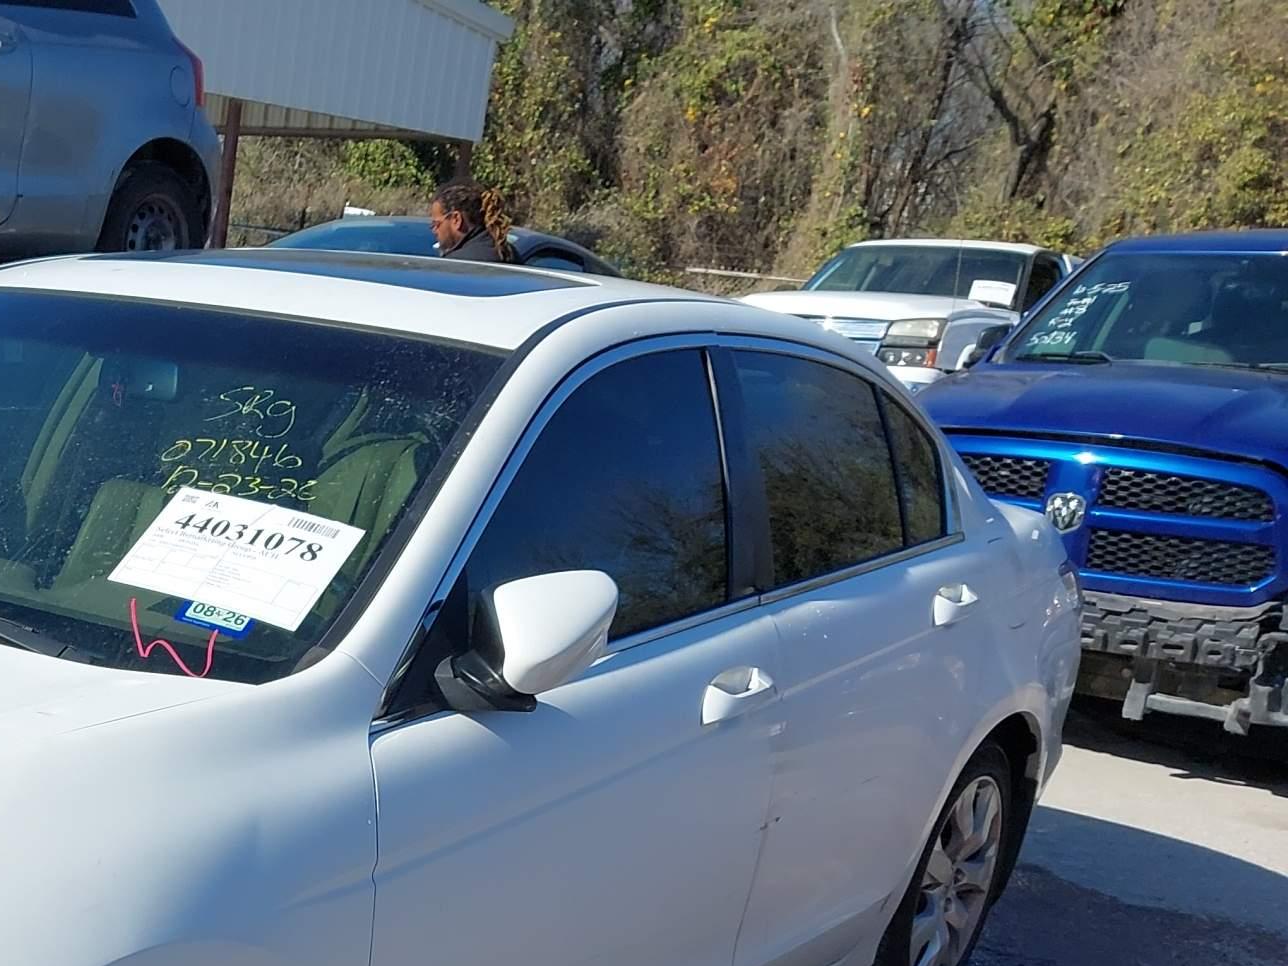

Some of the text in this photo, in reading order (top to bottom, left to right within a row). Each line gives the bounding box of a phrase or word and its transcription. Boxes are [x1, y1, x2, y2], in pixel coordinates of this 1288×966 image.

[175, 513, 323, 561] 44031078
[193, 602, 217, 617] 08
[222, 611, 247, 626] 26
